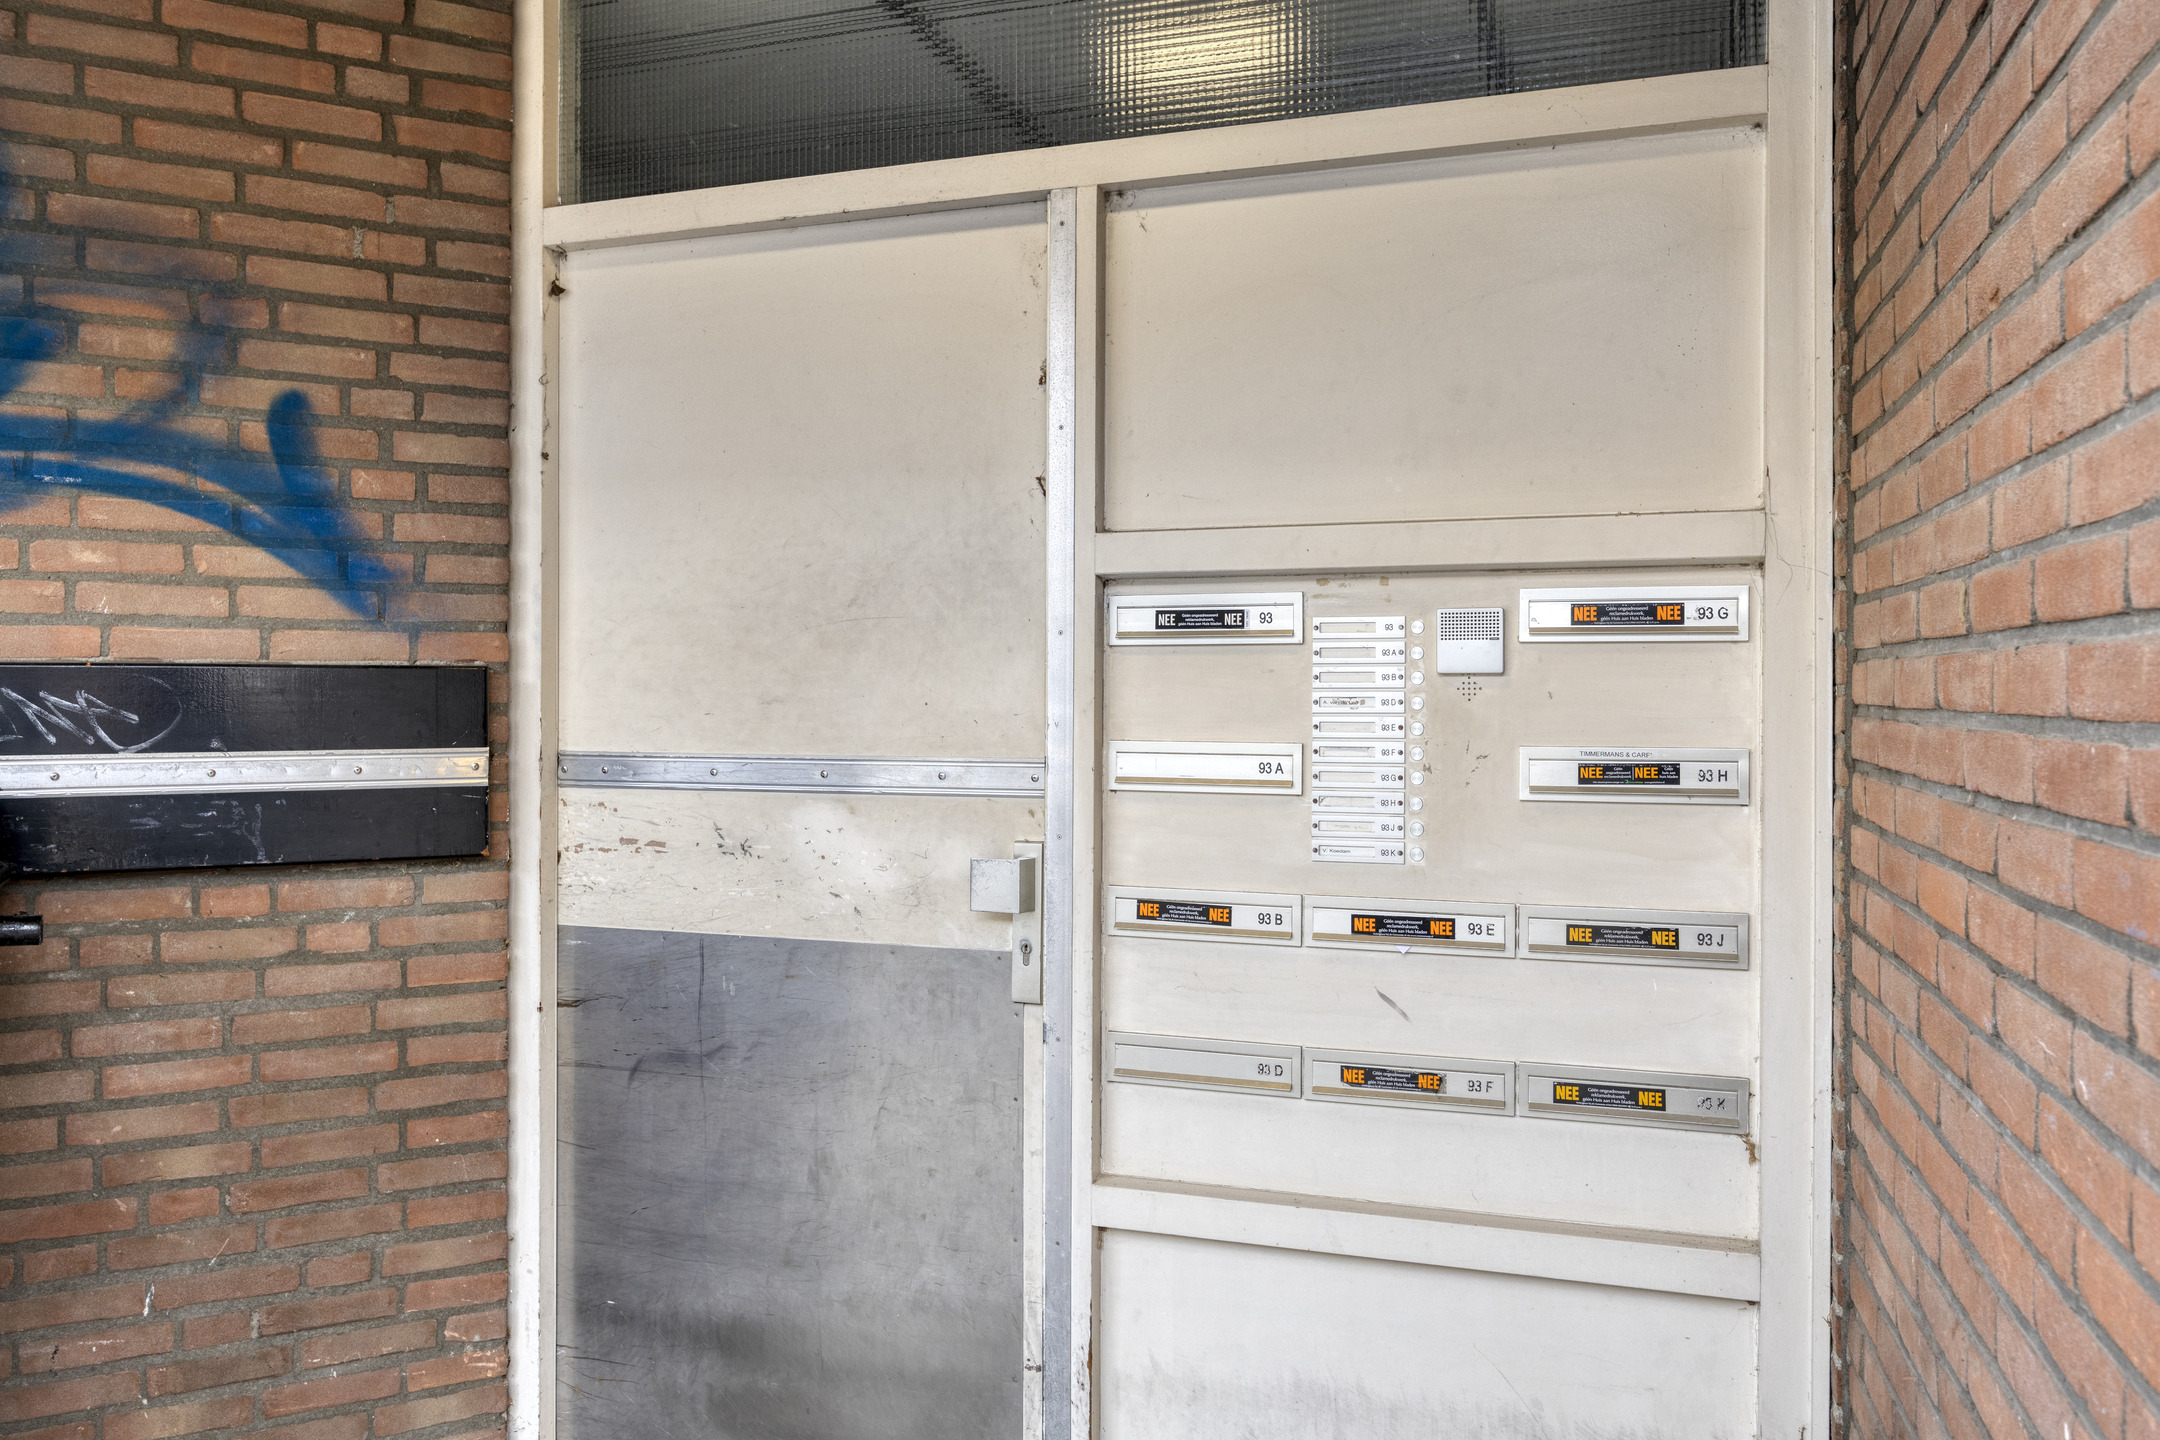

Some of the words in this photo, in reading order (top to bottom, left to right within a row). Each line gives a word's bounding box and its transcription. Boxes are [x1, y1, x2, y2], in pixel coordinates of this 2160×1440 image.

[1158, 614, 1176, 626] NEE
[1224, 613, 1242, 626] NEE
[1259, 612, 1273, 624] 93
[1574, 606, 1597, 621] NEE
[1656, 605, 1681, 621] NEE
[1698, 607, 1714, 620] 93
[1718, 607, 1729, 619] G
[1259, 762, 1272, 774] 93
[1275, 762, 1284, 774] A
[1580, 767, 1603, 779] NEE
[1635, 767, 1658, 779] NEE
[1698, 769, 1713, 782] 93
[1718, 770, 1728, 782] H
[1140, 903, 1159, 917] NEE
[1209, 908, 1229, 922] NEE
[1258, 913, 1271, 925] 93
[1275, 914, 1283, 925] B
[1354, 918, 1376, 932] NEE
[1430, 921, 1452, 936] NEE
[1468, 923, 1482, 935] 93
[1487, 924, 1495, 936] E
[1570, 928, 1592, 942] NEE
[1652, 931, 1676, 946] NEE
[1697, 933, 1713, 946] 93
[1717, 934, 1724, 947] J
[1258, 1063, 1270, 1075] 93
[1275, 1065, 1283, 1077] D
[1343, 1069, 1365, 1084] NEE
[1418, 1074, 1440, 1090] NEE
[1468, 1080, 1482, 1092] 93
[1486, 1081, 1495, 1093] F
[1556, 1085, 1579, 1101] NEE
[1639, 1091, 1663, 1107] NEE
